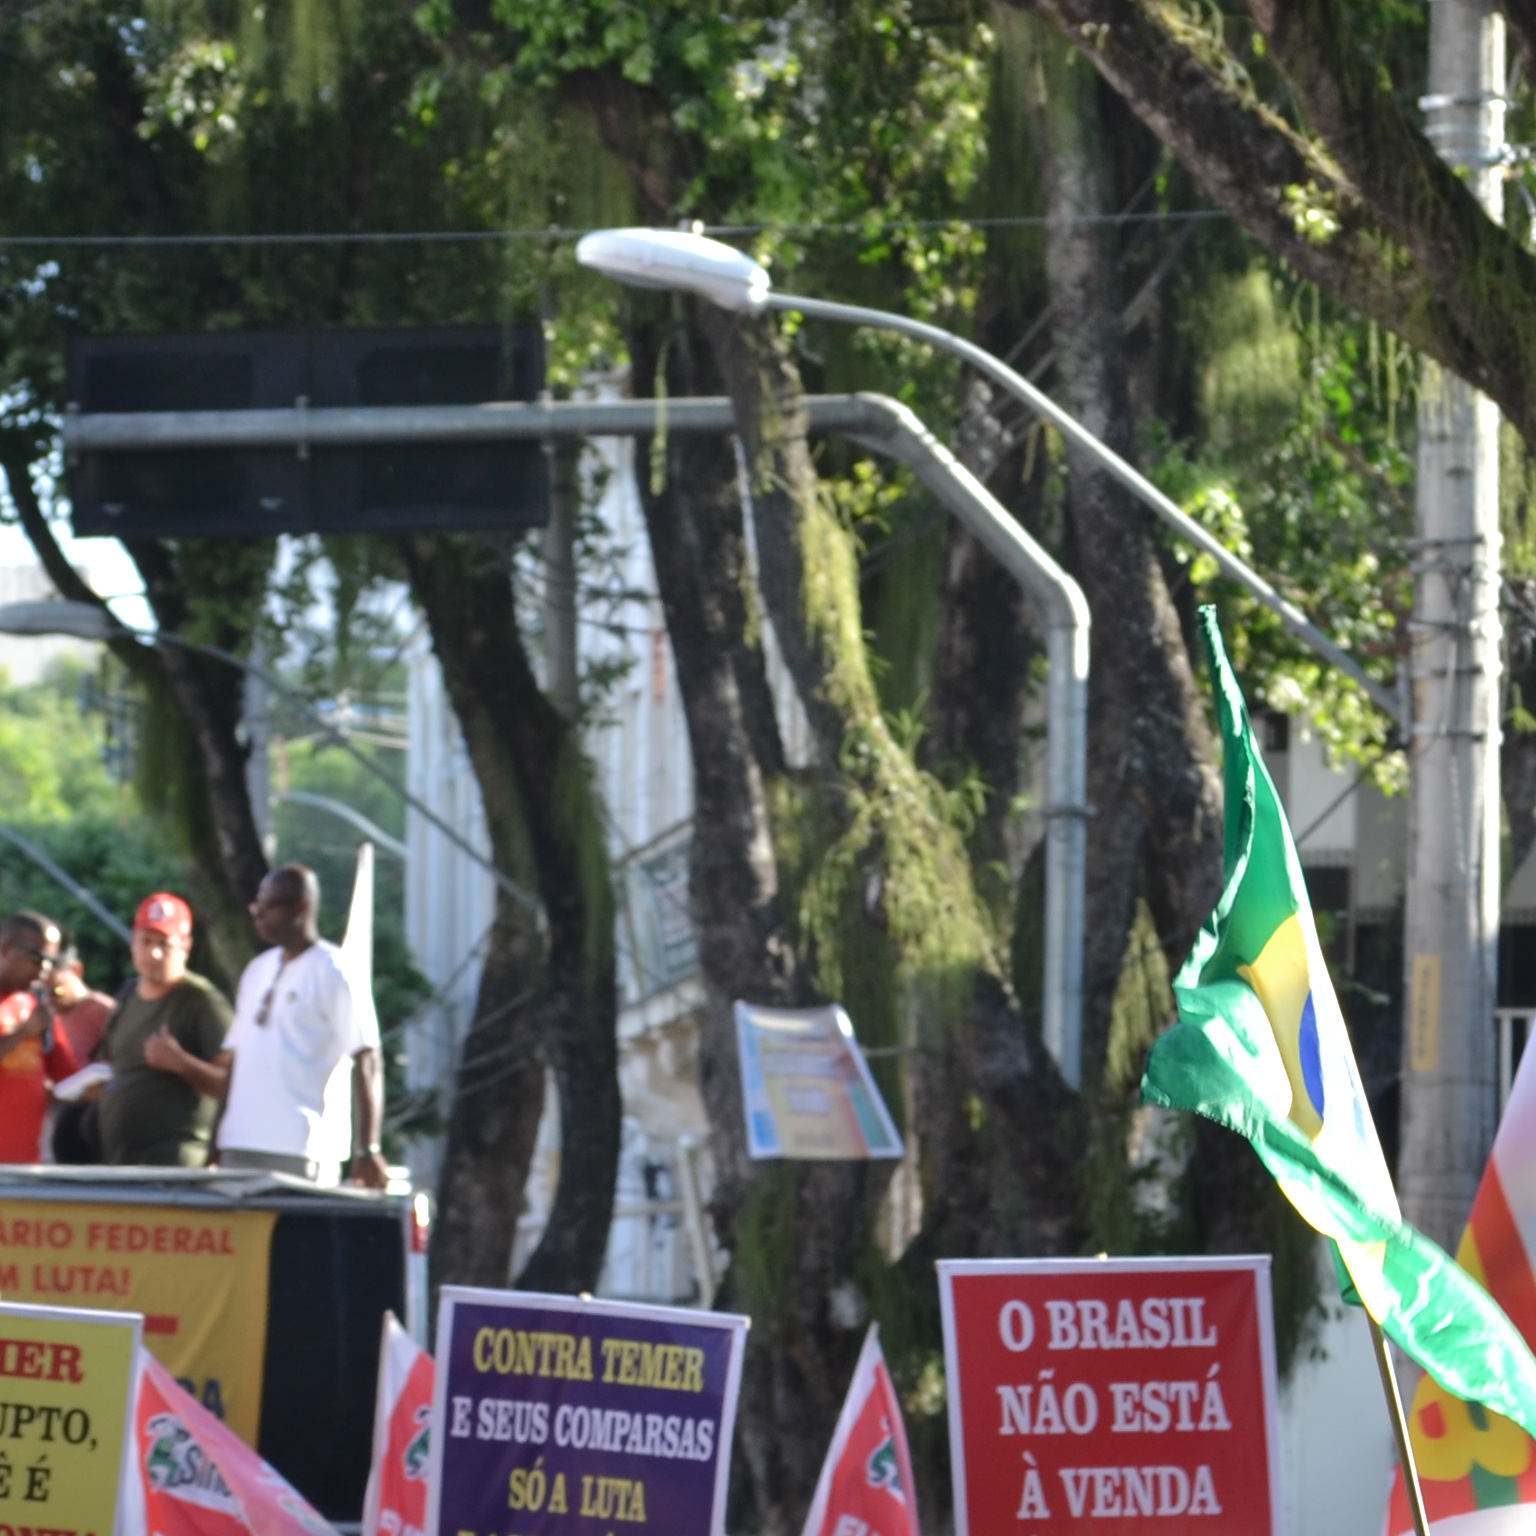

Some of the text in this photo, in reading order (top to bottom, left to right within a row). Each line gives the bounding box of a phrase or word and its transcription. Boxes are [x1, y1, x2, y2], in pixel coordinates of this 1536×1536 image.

[86, 1222, 235, 1256] FEDERAL
[33, 1265, 132, 1296] LUTA!
[999, 1298, 1218, 1352] O BRASIL
[473, 1327, 705, 1393] CONTRA TEMER
[451, 1396, 715, 1461] E SEUS COMPARSAS
[997, 1362, 1233, 1435] NÃO ESTÁ
[24, 1455, 52, 1502] É
[508, 1455, 647, 1522] SÓ A LUTA
[1016, 1449, 1222, 1520] À VENDA
